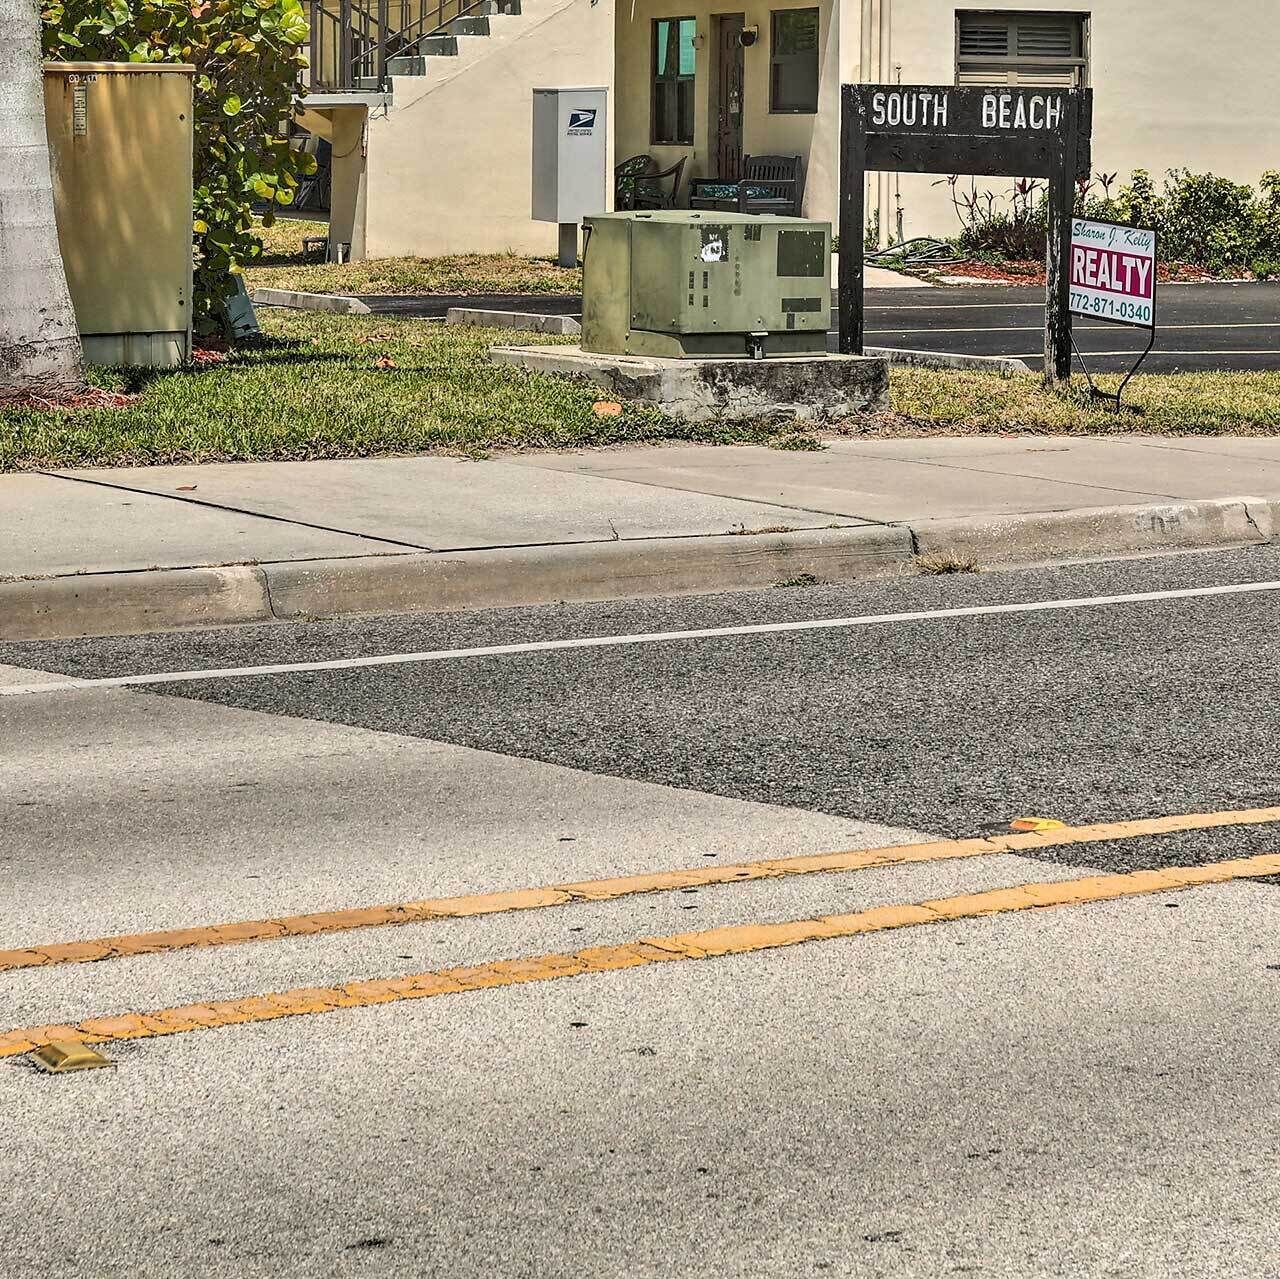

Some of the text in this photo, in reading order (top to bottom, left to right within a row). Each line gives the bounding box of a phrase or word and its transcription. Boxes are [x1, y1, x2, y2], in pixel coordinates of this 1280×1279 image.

[872, 92, 1062, 130] SOUTH BEACH
[1073, 222, 1106, 240] Sharon
[1124, 229, 1152, 252] Kelly
[1072, 247, 1151, 295] REALTY
[1070, 292, 1151, 322] 772-871-0340
